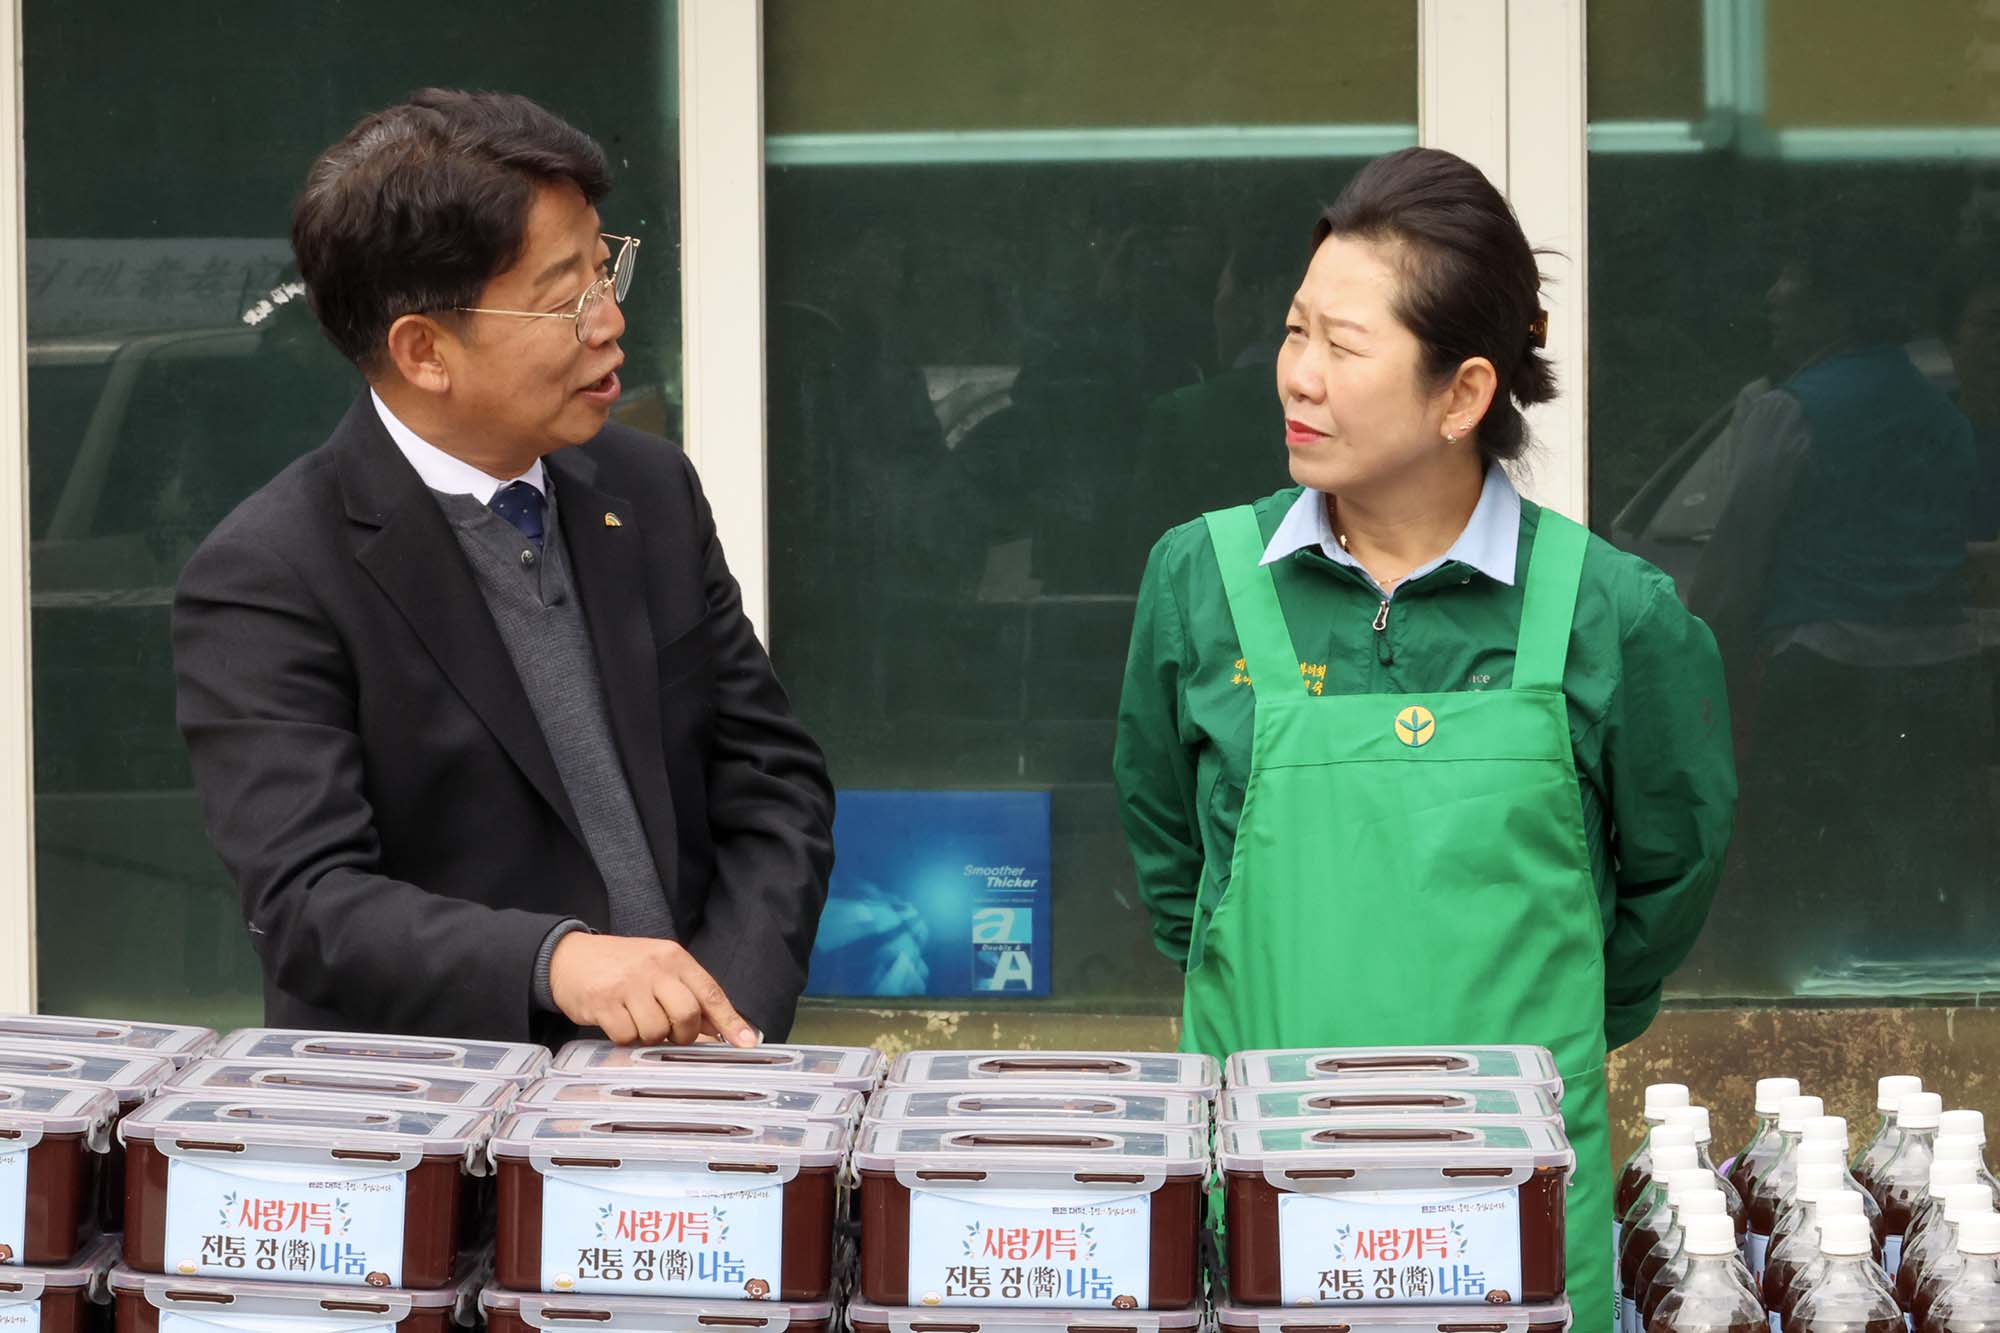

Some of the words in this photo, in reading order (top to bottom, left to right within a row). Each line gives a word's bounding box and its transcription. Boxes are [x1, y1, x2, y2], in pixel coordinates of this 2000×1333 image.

[964, 864, 1025, 877] Smoother
[986, 876, 1038, 888] Thicker
[992, 951, 1032, 990] A
[239, 1199, 333, 1235] 사랑가득
[615, 1210, 709, 1244] 사랑가득
[200, 1234, 246, 1268] 전통
[982, 1227, 1077, 1261] 사랑가득
[1354, 1226, 1448, 1261] 사랑가득
[577, 1248, 623, 1280] 전통
[945, 1266, 991, 1297] 전통
[1318, 1269, 1364, 1300] 전통
